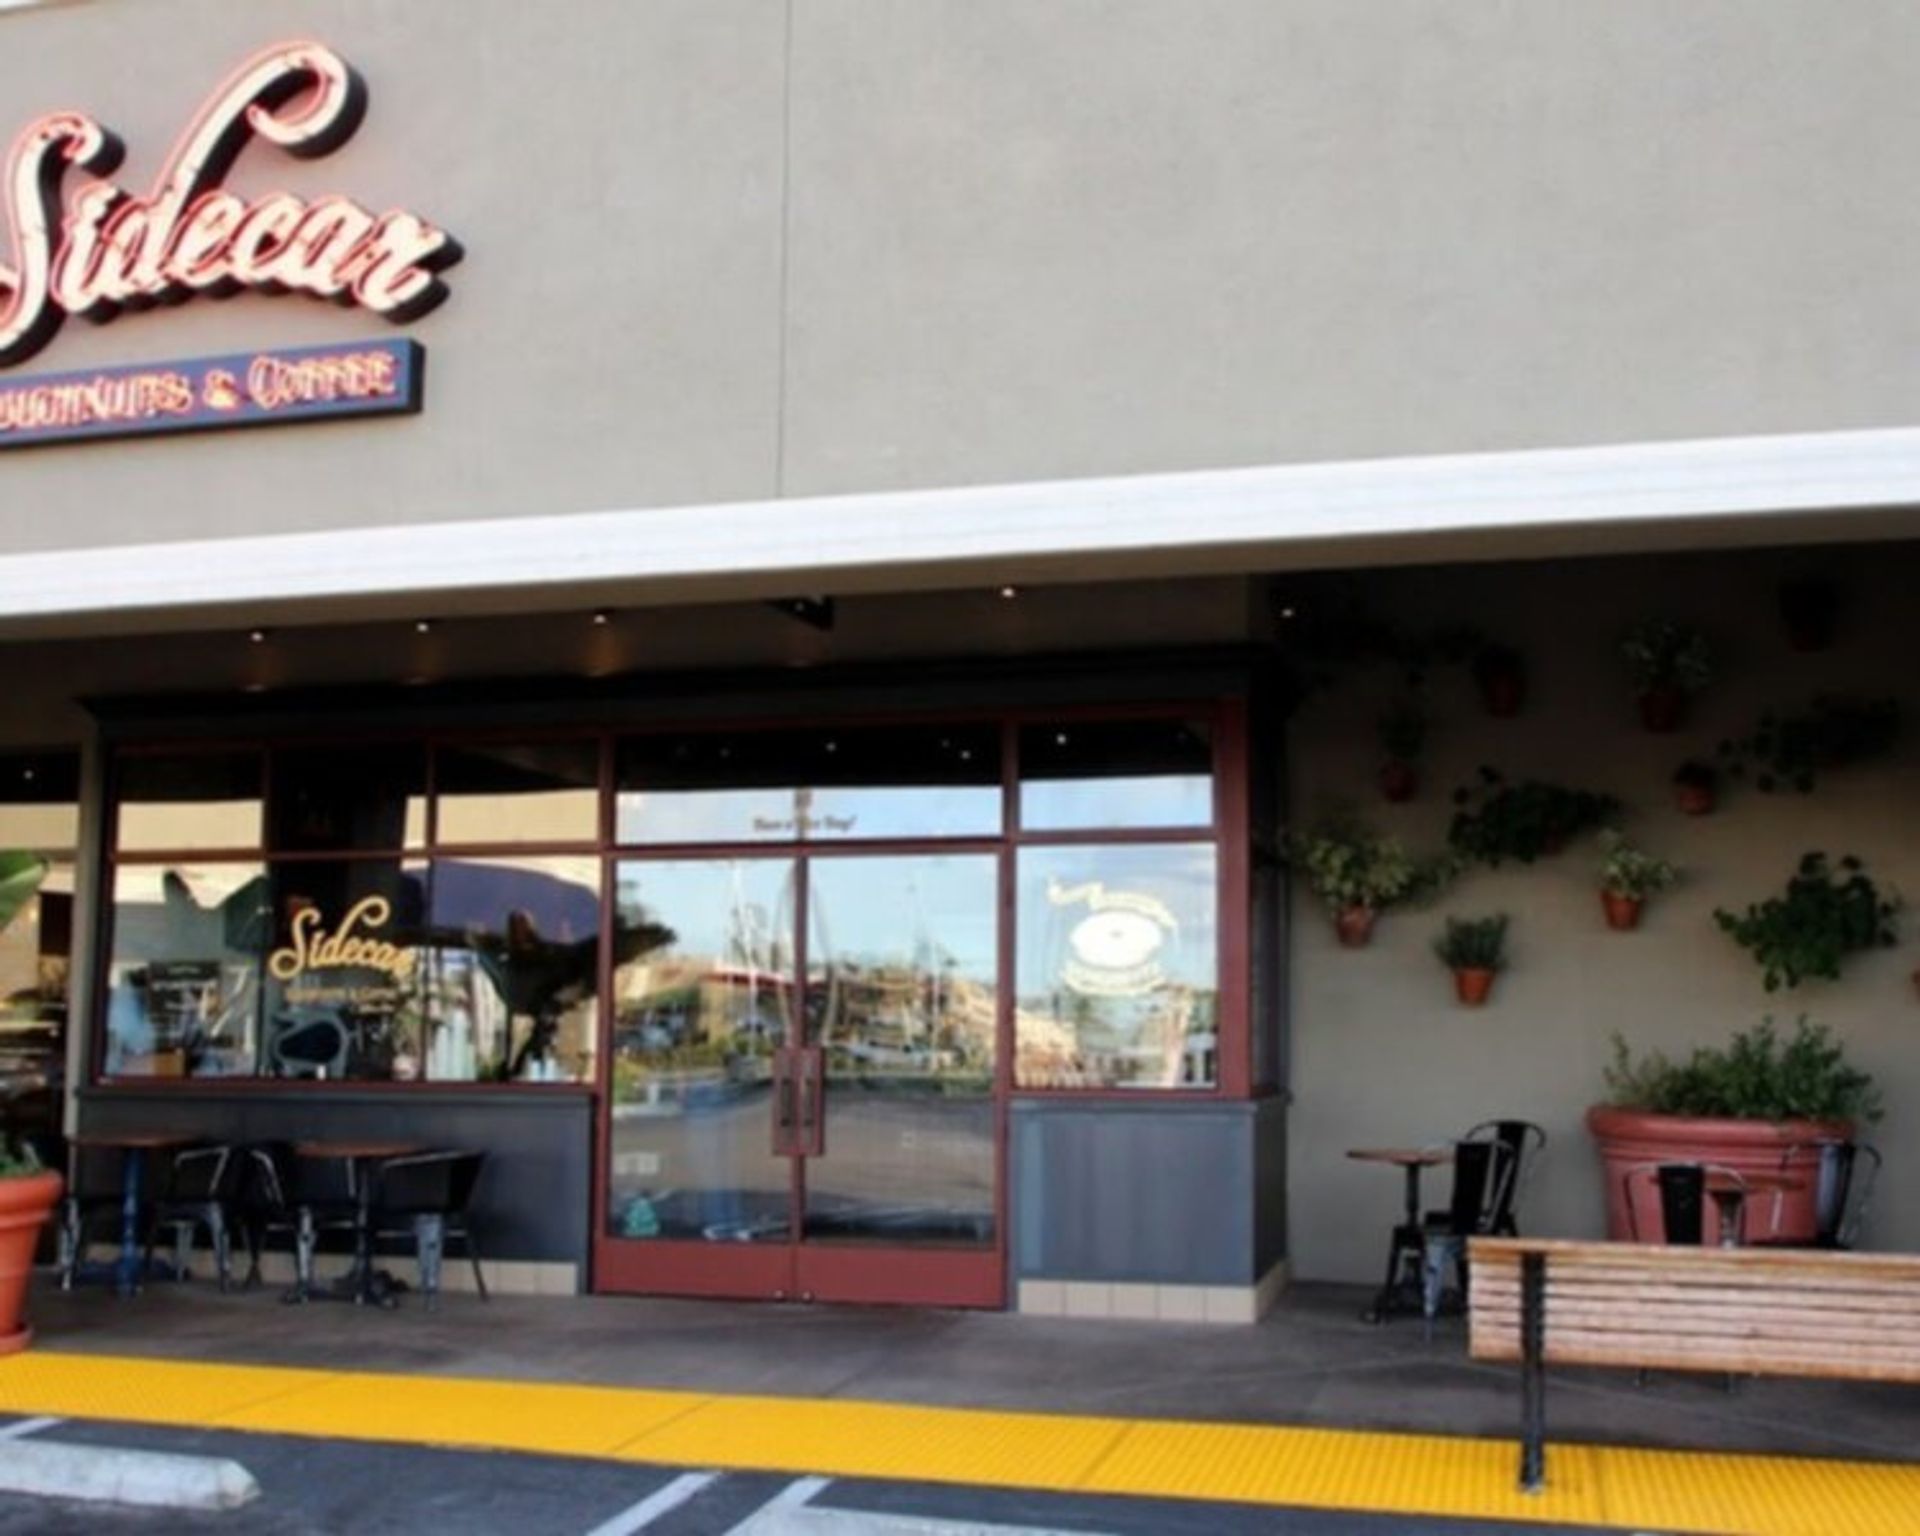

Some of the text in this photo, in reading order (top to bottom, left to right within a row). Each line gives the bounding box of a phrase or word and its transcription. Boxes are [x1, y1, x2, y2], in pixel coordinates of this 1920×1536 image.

[0, 40, 456, 356] Sidecar
[203, 369, 238, 410] &
[269, 895, 415, 980] Sidecar
